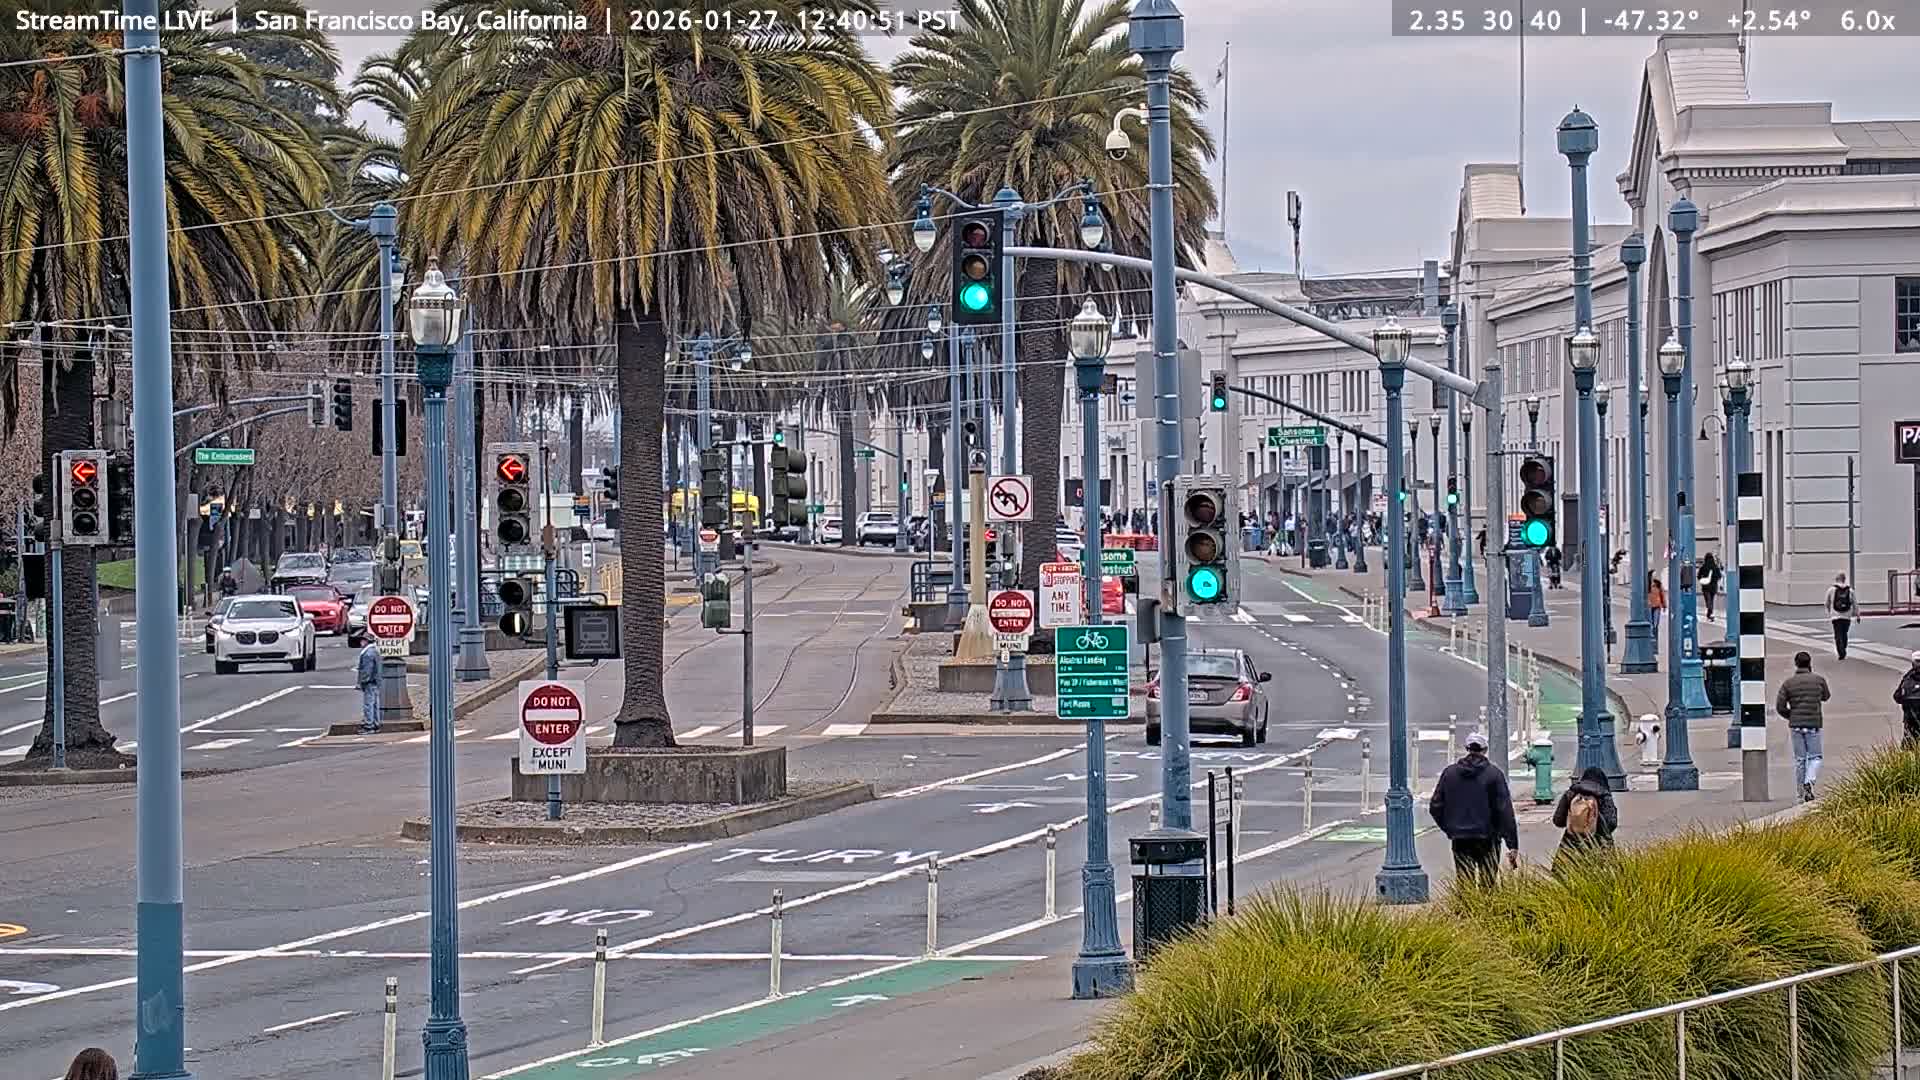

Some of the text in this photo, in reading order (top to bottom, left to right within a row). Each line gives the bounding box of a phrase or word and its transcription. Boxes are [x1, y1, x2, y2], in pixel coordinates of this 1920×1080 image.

[1101, 551, 1127, 560] some
[1052, 591, 1069, 601] ANY
[375, 605, 406, 613] DO NOT
[1051, 602, 1071, 612] TIME
[999, 619, 1023, 627] ENTER
[378, 625, 404, 633] ENTER
[533, 697, 571, 706] DO NOT
[535, 724, 570, 734] ENTER
[532, 748, 572, 758] EXCEPT
[538, 760, 567, 769] MUNI
[712, 848, 944, 864] TURN
[500, 908, 654, 926] NO
